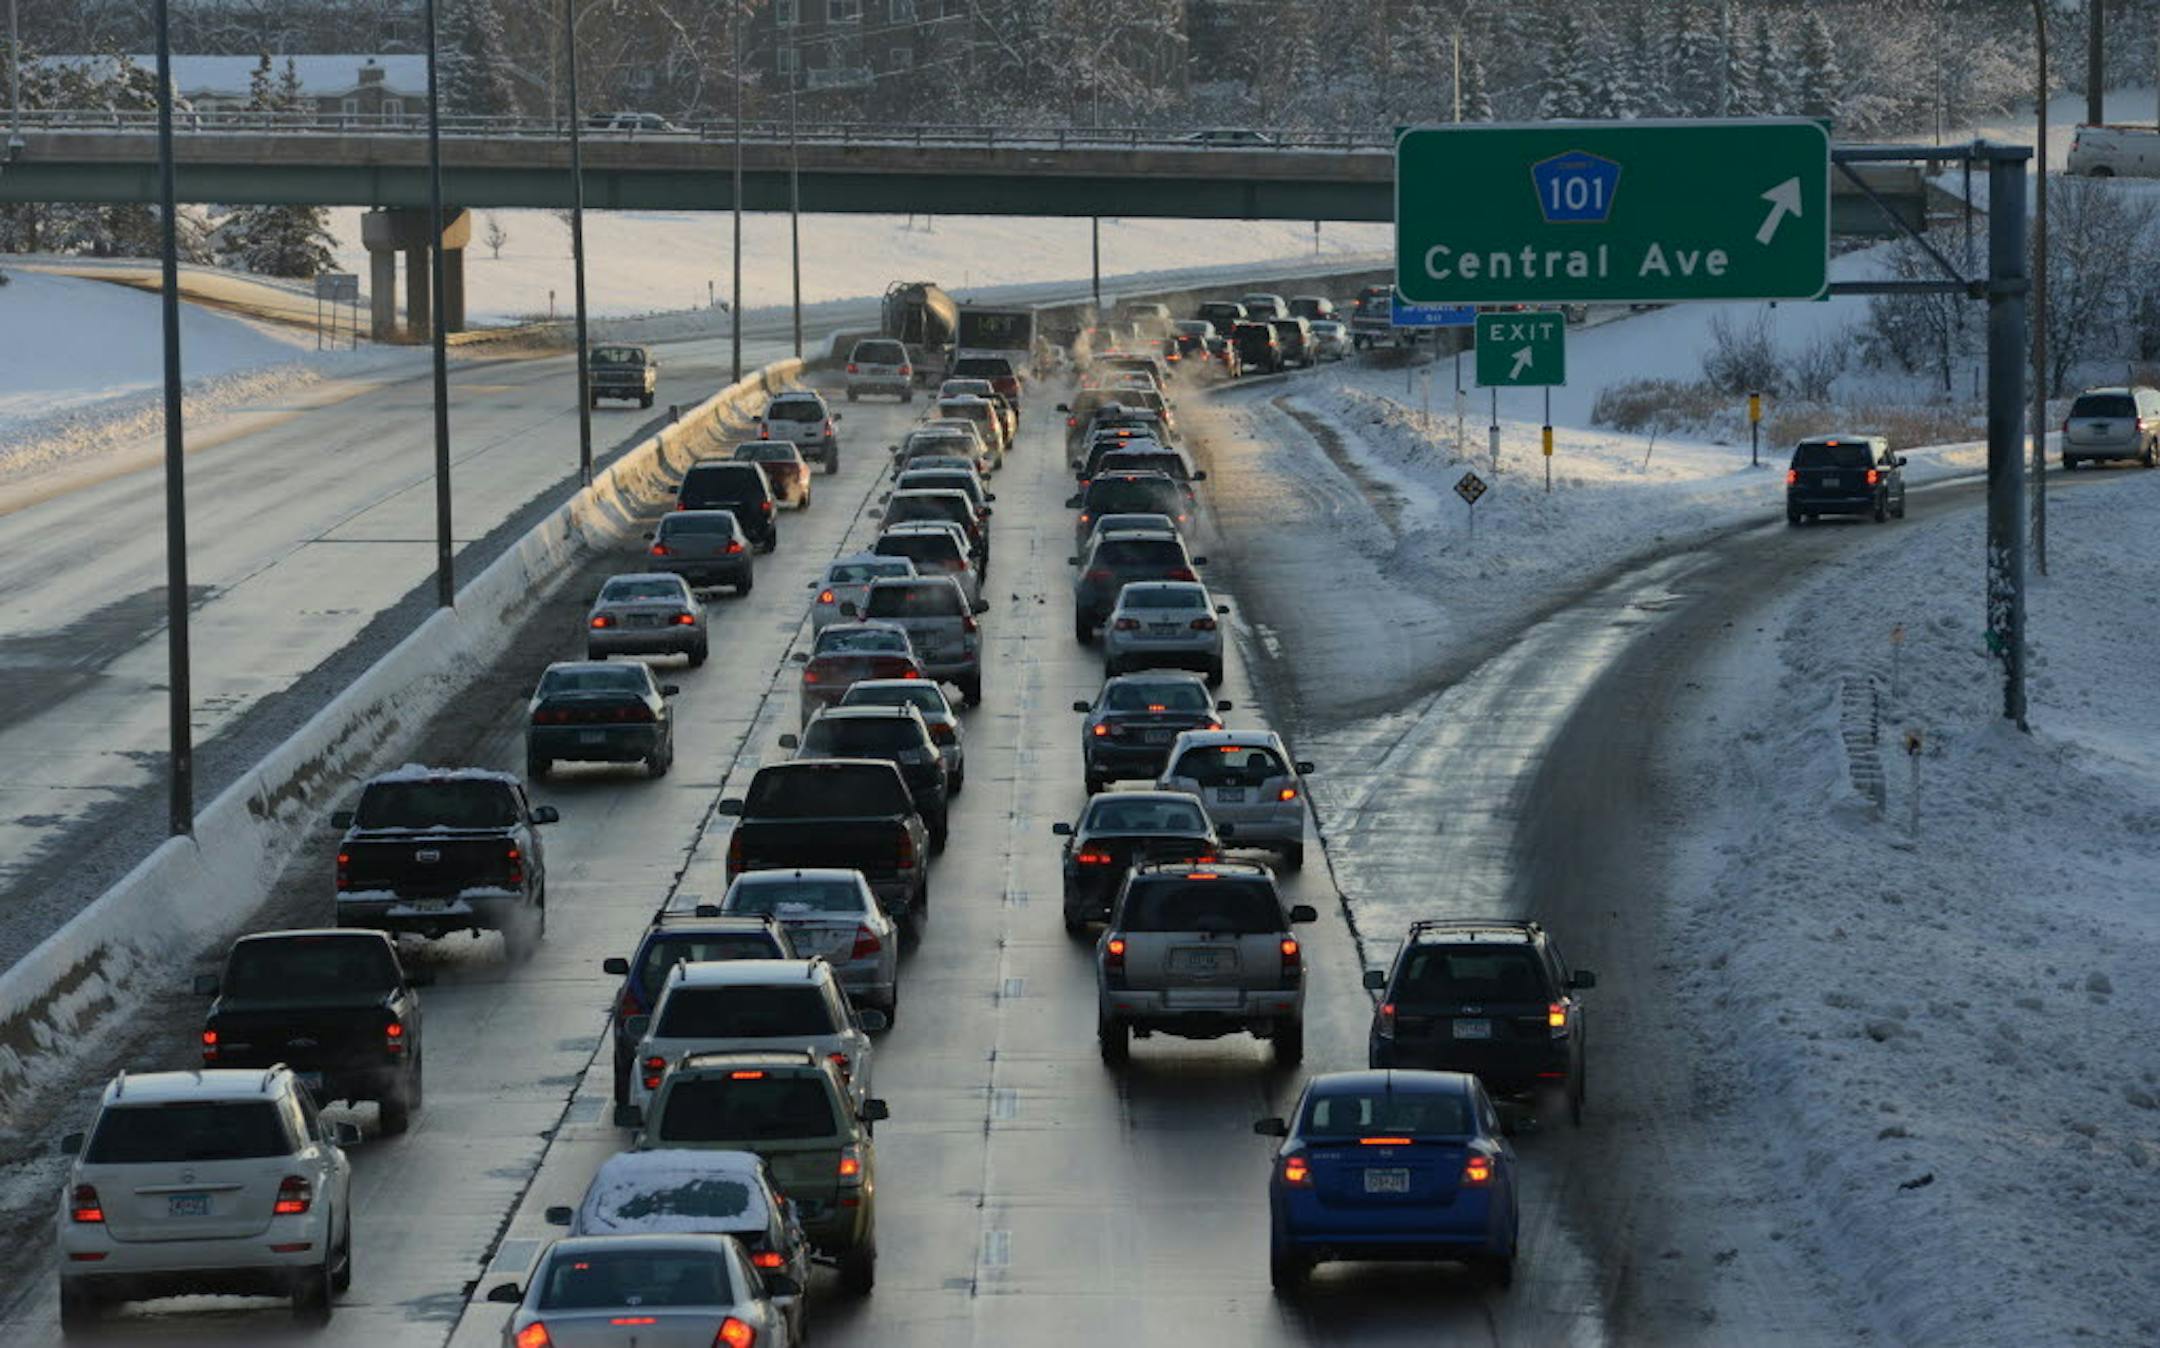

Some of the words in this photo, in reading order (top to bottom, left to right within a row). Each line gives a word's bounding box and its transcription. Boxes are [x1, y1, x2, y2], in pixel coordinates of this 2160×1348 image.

[1550, 177, 1603, 210] 101
[1425, 244, 1608, 279] Central
[1638, 243, 1729, 276] Ave
[1490, 323, 1554, 341] EXIT
